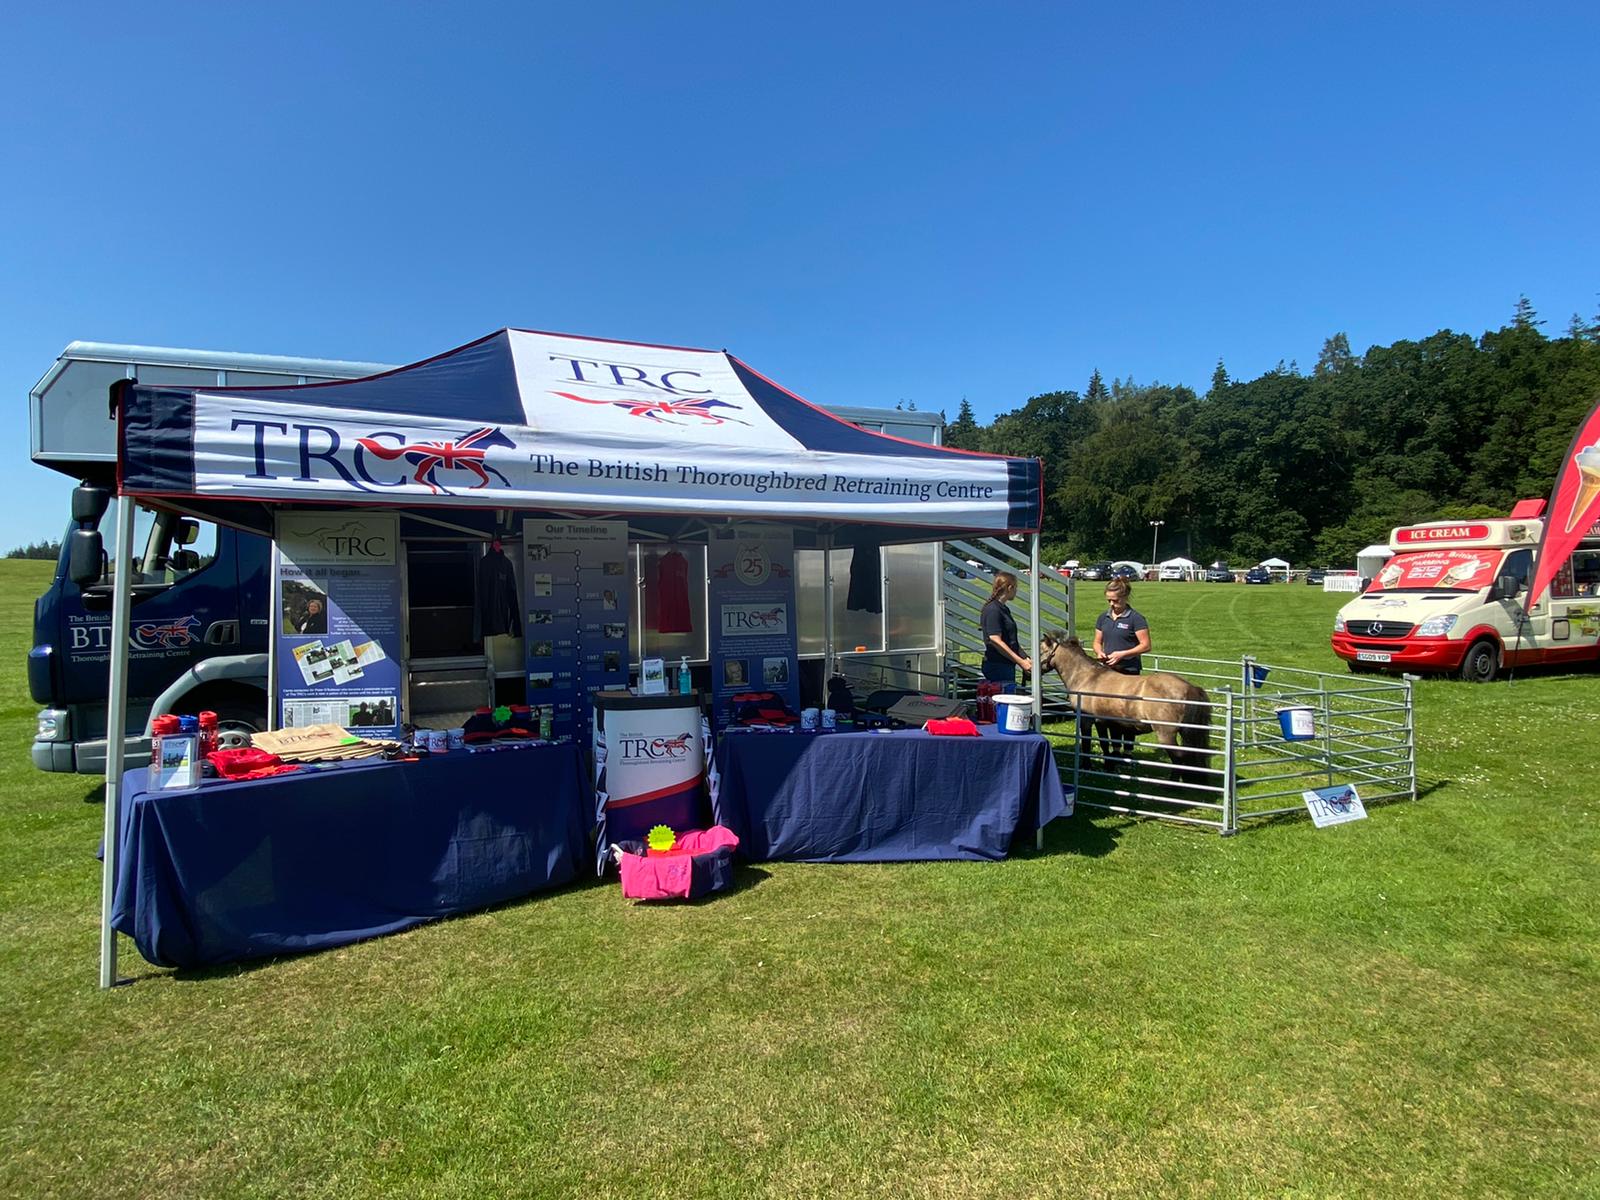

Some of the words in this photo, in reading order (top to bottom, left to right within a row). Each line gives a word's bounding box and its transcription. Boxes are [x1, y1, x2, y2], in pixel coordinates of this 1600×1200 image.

[549, 356, 713, 395] TRC
[231, 419, 407, 493] TRC
[530, 454, 579, 476] The
[587, 459, 668, 482] British
[676, 465, 828, 493] Thoroughbred
[832, 475, 932, 501] Retraining
[936, 481, 993, 499] Centre
[545, 525, 564, 534] Our
[567, 525, 608, 534] Timeline
[1410, 530, 1427, 539] ICE
[1429, 528, 1470, 538] CREAM
[327, 537, 386, 557] TRC
[280, 568, 302, 577] How
[315, 567, 328, 576] all
[743, 559, 763, 577] 25
[724, 610, 761, 629] TRC
[70, 624, 159, 650] BTC
[619, 738, 665, 759] TRC
[1308, 796, 1343, 817] TRC
